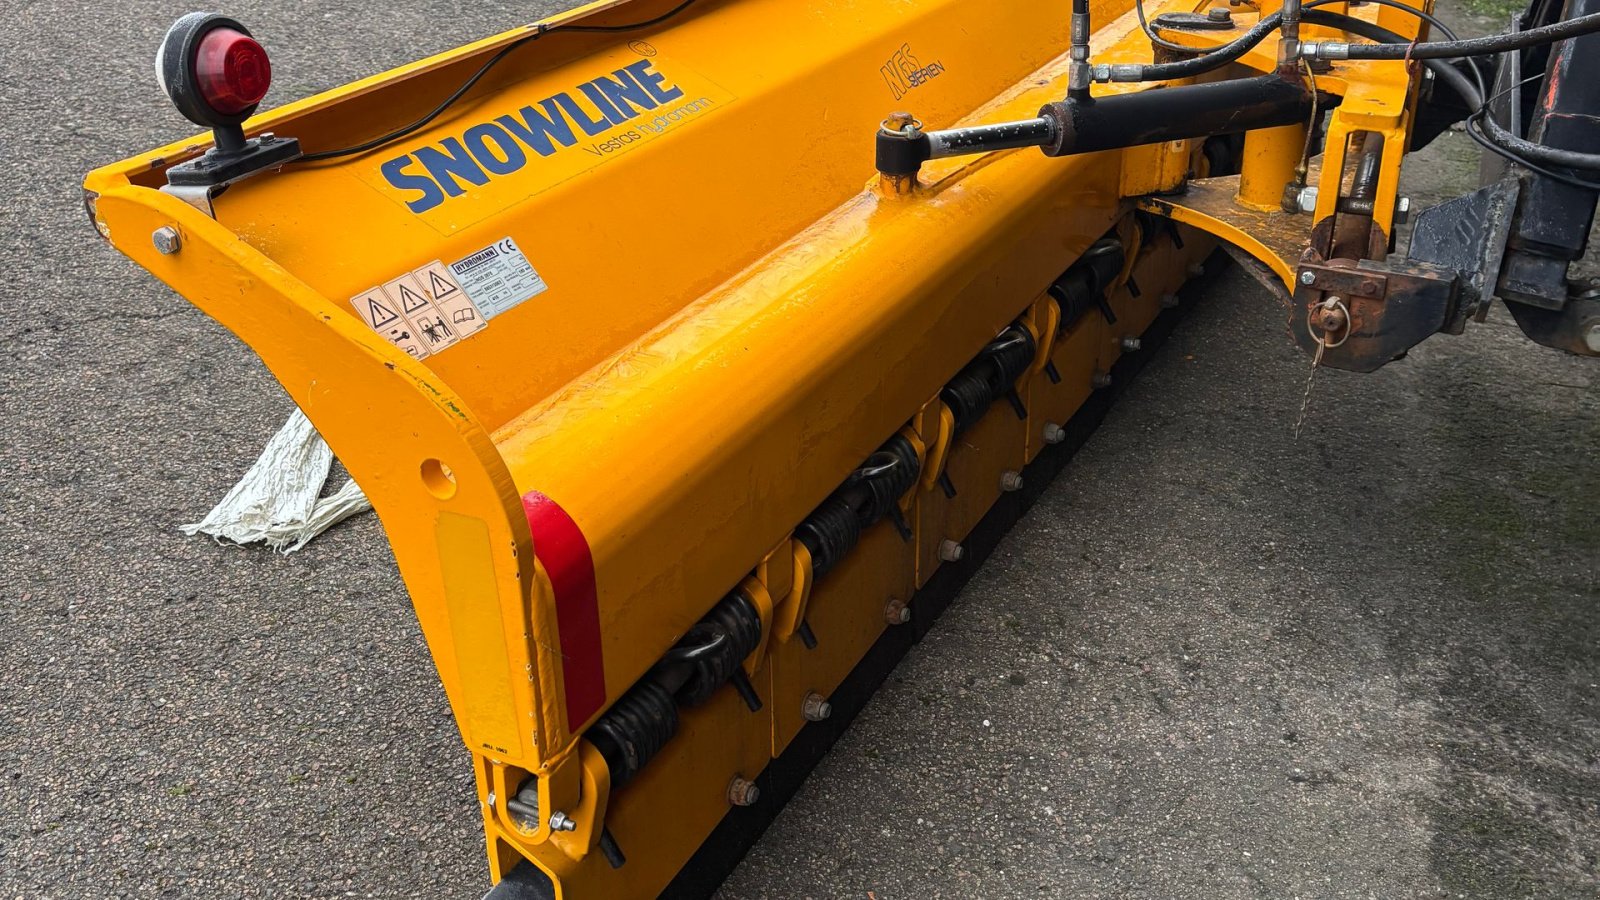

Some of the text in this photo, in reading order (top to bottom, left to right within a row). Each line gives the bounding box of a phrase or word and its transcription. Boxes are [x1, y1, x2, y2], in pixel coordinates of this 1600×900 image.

[908, 60, 945, 87] SERIEN
[380, 58, 684, 214] SNOWLINE
[582, 97, 715, 157] Vestas hydromann
[455, 249, 496, 272] HYDROMANN
